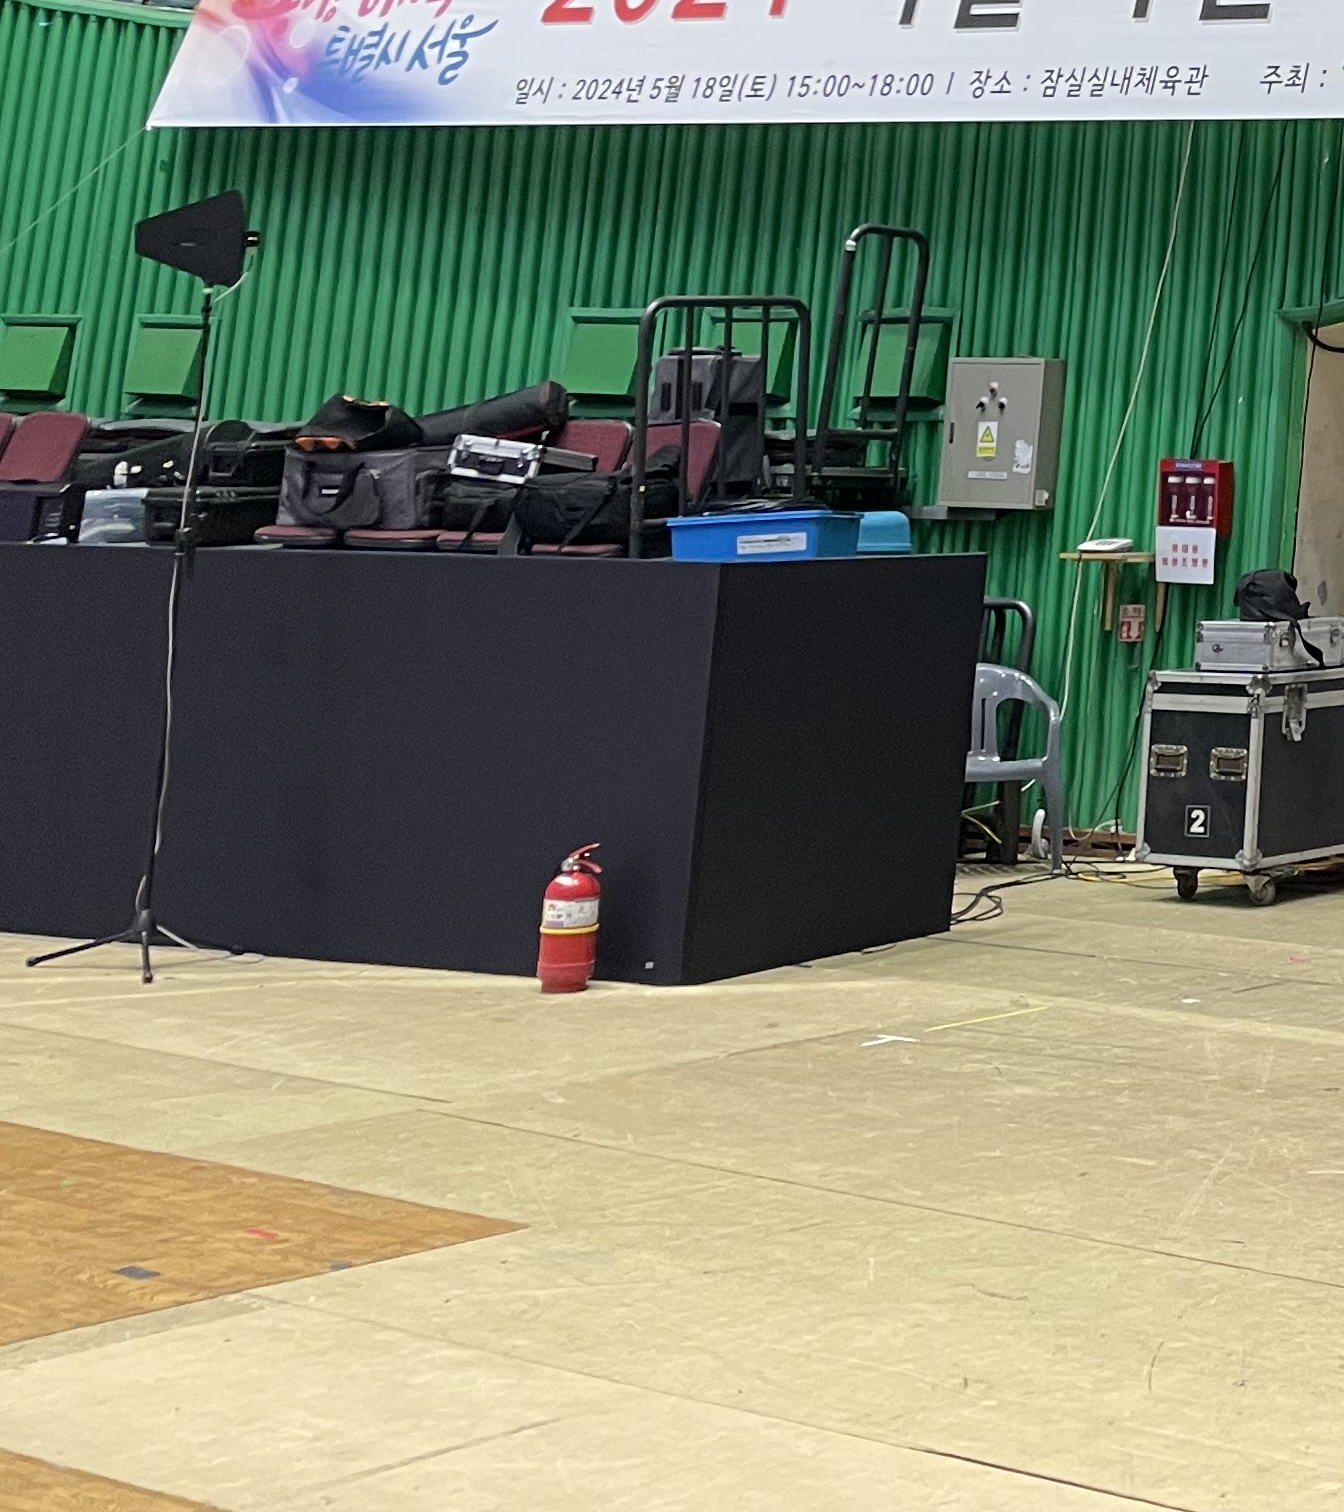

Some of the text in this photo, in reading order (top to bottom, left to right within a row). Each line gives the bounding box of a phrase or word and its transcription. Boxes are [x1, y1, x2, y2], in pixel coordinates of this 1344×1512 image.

[515, 76, 554, 105] 일시
[571, 77, 643, 103] 2024년
[647, 76, 686, 102] 5월
[692, 75, 777, 103] 18일(토)
[785, 71, 936, 99] 15:00~18:00
[968, 67, 1013, 97] 장소
[1040, 63, 1209, 98] 잠실실내체육관
[1259, 61, 1309, 94] 주최
[1190, 810, 1206, 833] 2
